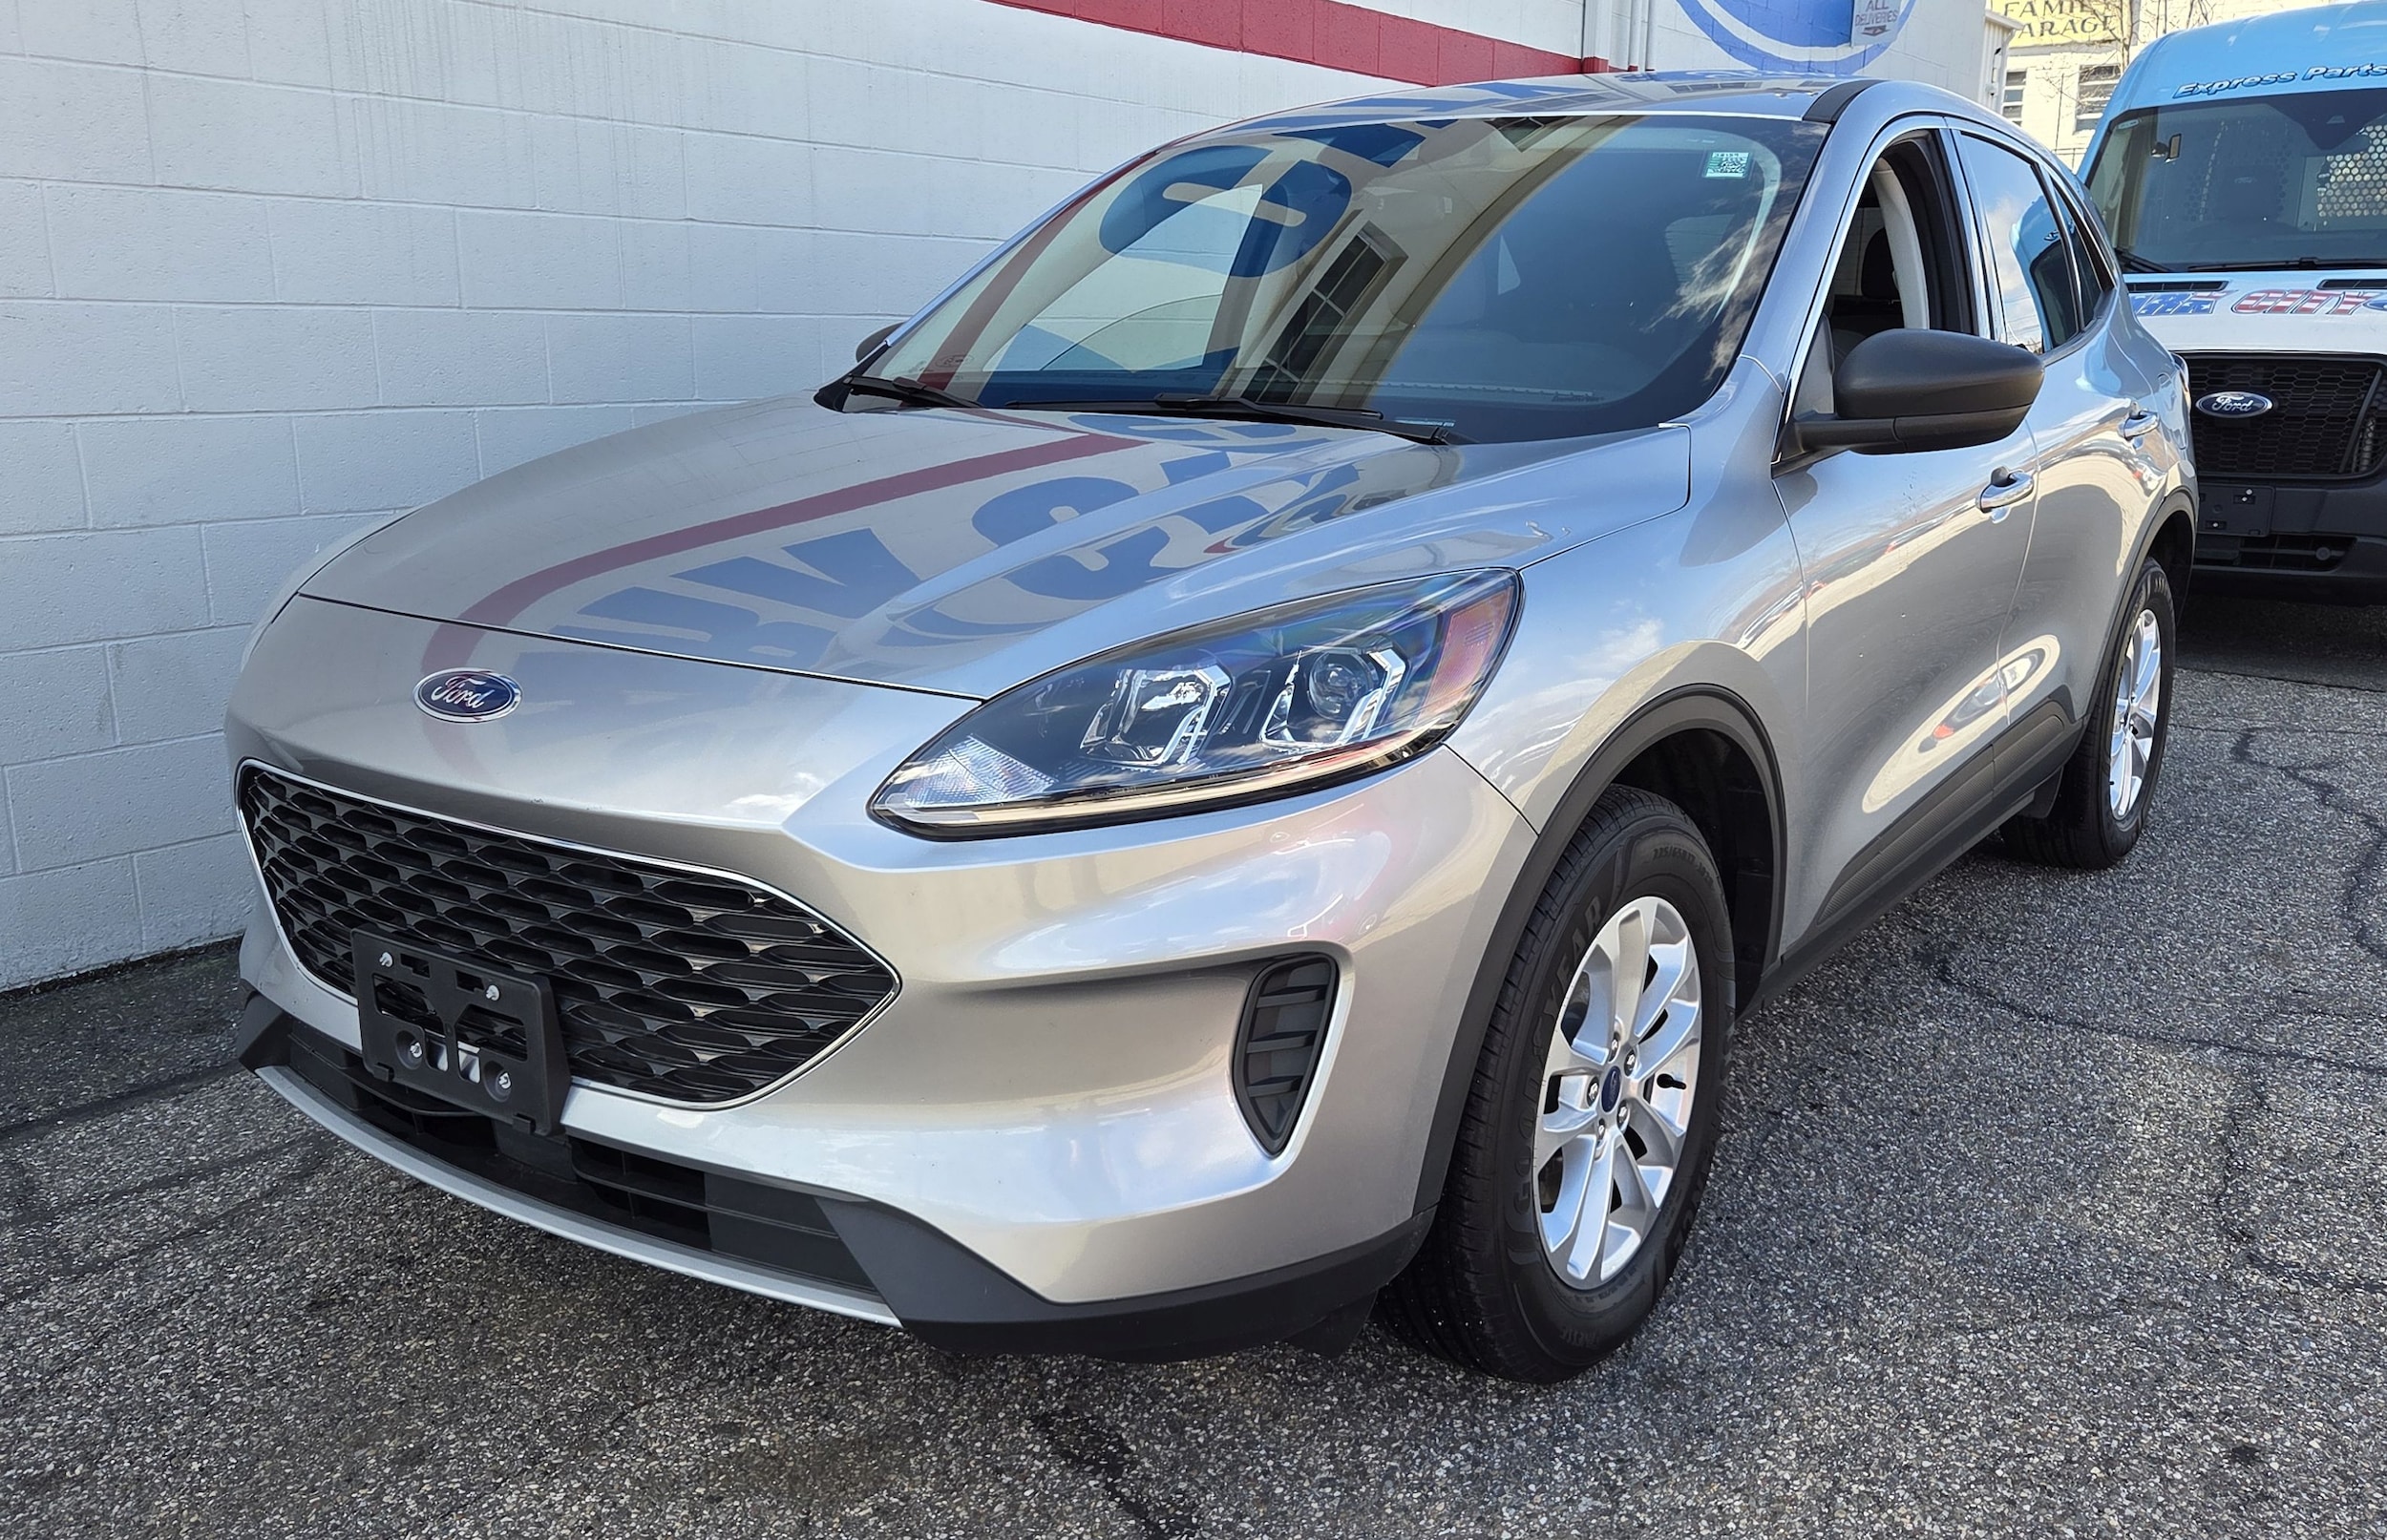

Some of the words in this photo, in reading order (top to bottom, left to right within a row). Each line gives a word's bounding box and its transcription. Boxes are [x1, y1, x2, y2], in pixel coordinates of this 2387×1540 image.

[1865, 0, 1890, 11] ALL
[1854, 10, 1899, 27] DELIVERIES
[2172, 72, 2297, 99] Express
[2301, 63, 2387, 80] Parts
[2230, 288, 2383, 315] CITY
